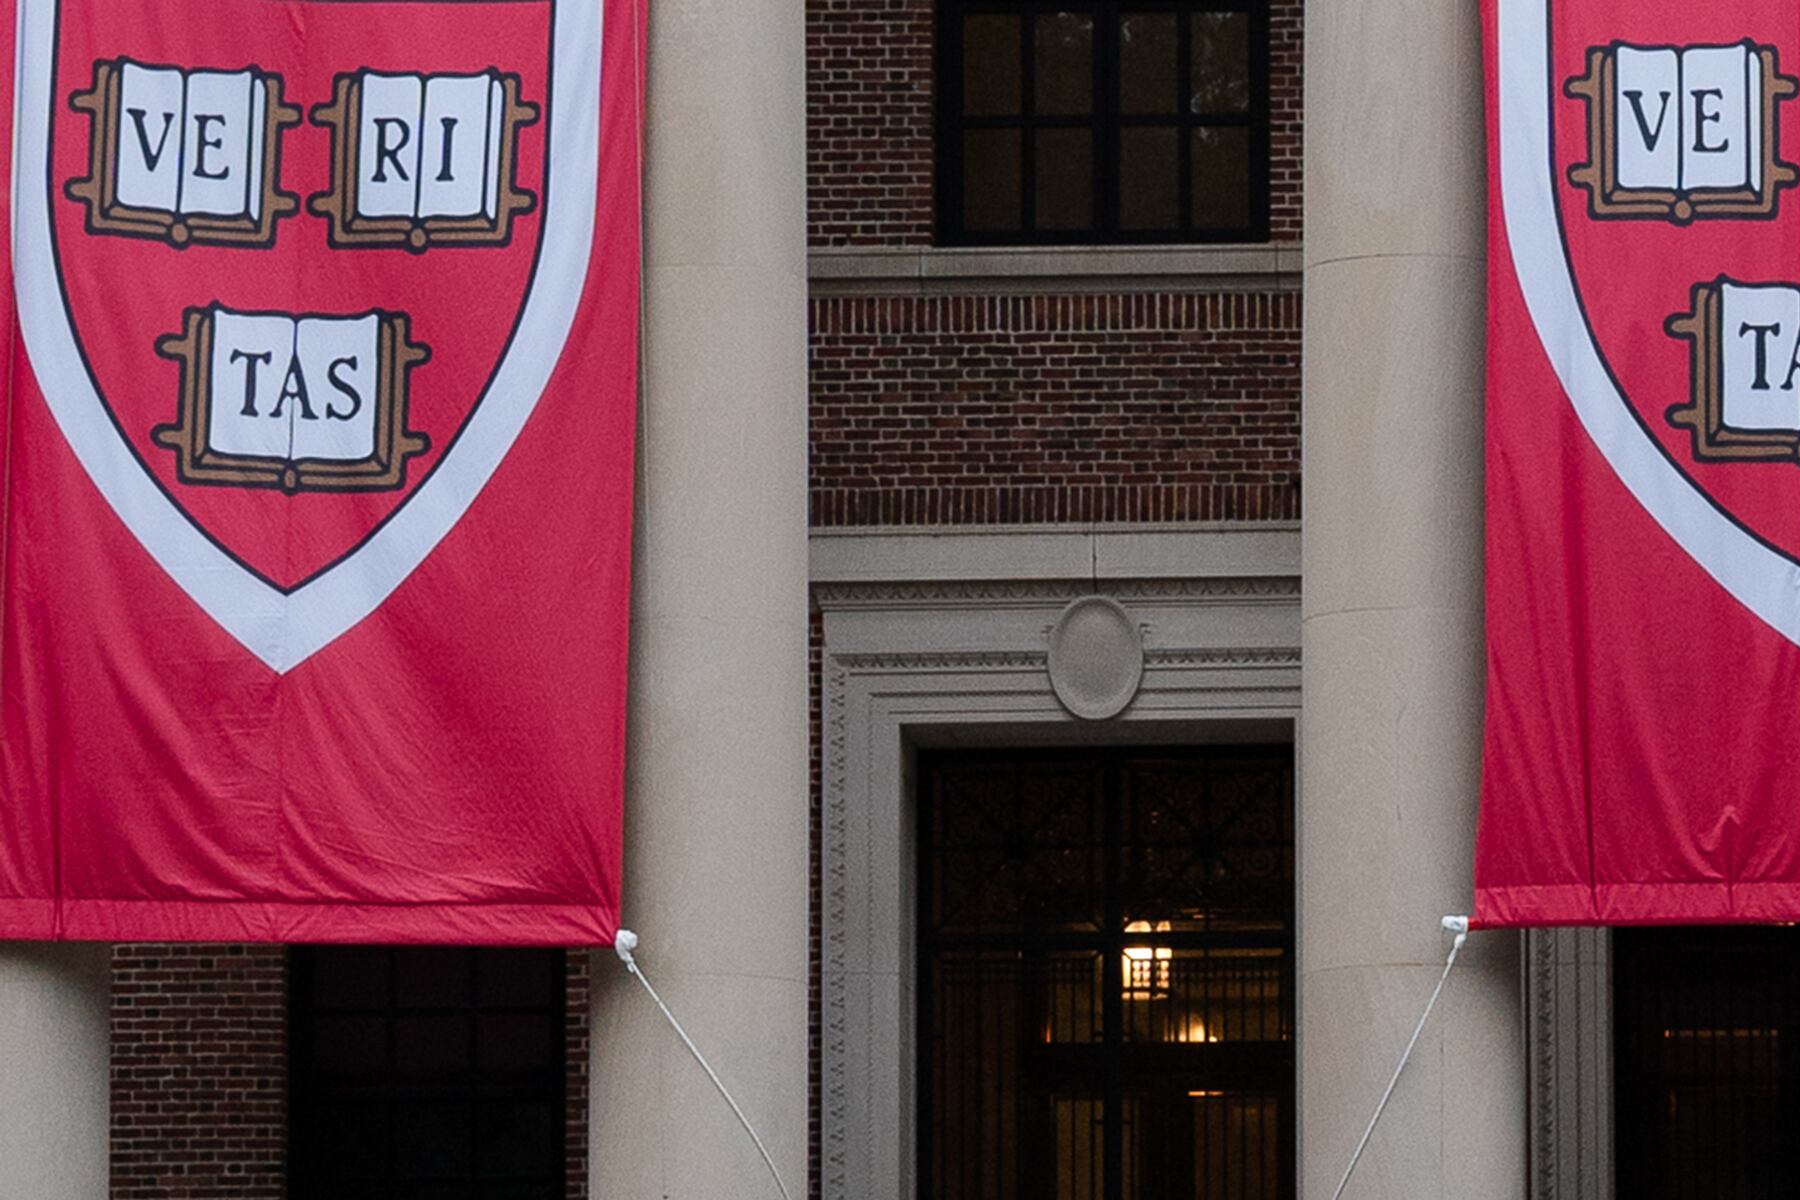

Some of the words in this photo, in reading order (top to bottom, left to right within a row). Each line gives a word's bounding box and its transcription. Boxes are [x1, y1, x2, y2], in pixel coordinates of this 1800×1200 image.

[126, 107, 230, 181] VE
[370, 116, 459, 184] RI
[1622, 89, 1730, 154] VE
[229, 348, 362, 422] TAS
